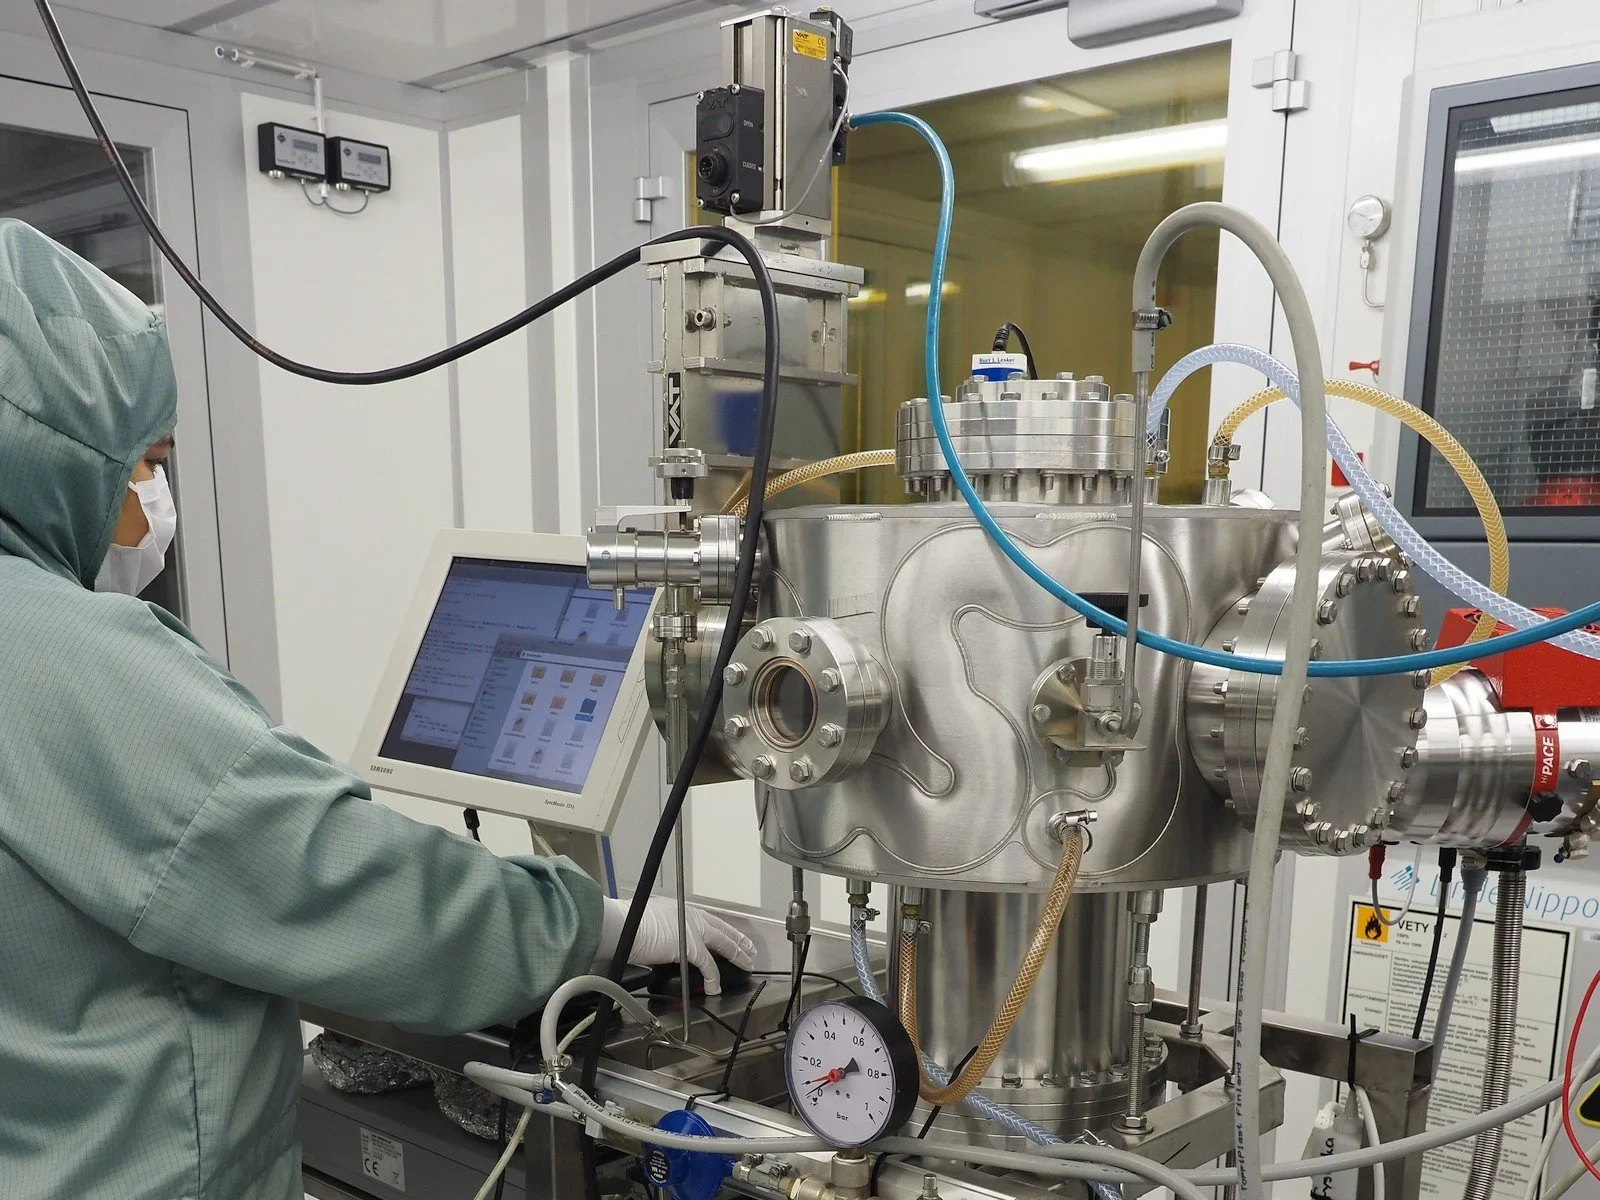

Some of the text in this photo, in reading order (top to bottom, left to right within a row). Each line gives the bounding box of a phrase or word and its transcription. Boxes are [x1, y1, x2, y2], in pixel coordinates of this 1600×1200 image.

[669, 377, 680, 446] VAT
[370, 765, 393, 775] SAMSUNG
[1430, 873, 1499, 906] Lne
[1398, 920, 1430, 933] VETY
[836, 1112, 848, 1121] bar
[364, 1158, 379, 1176] CE
